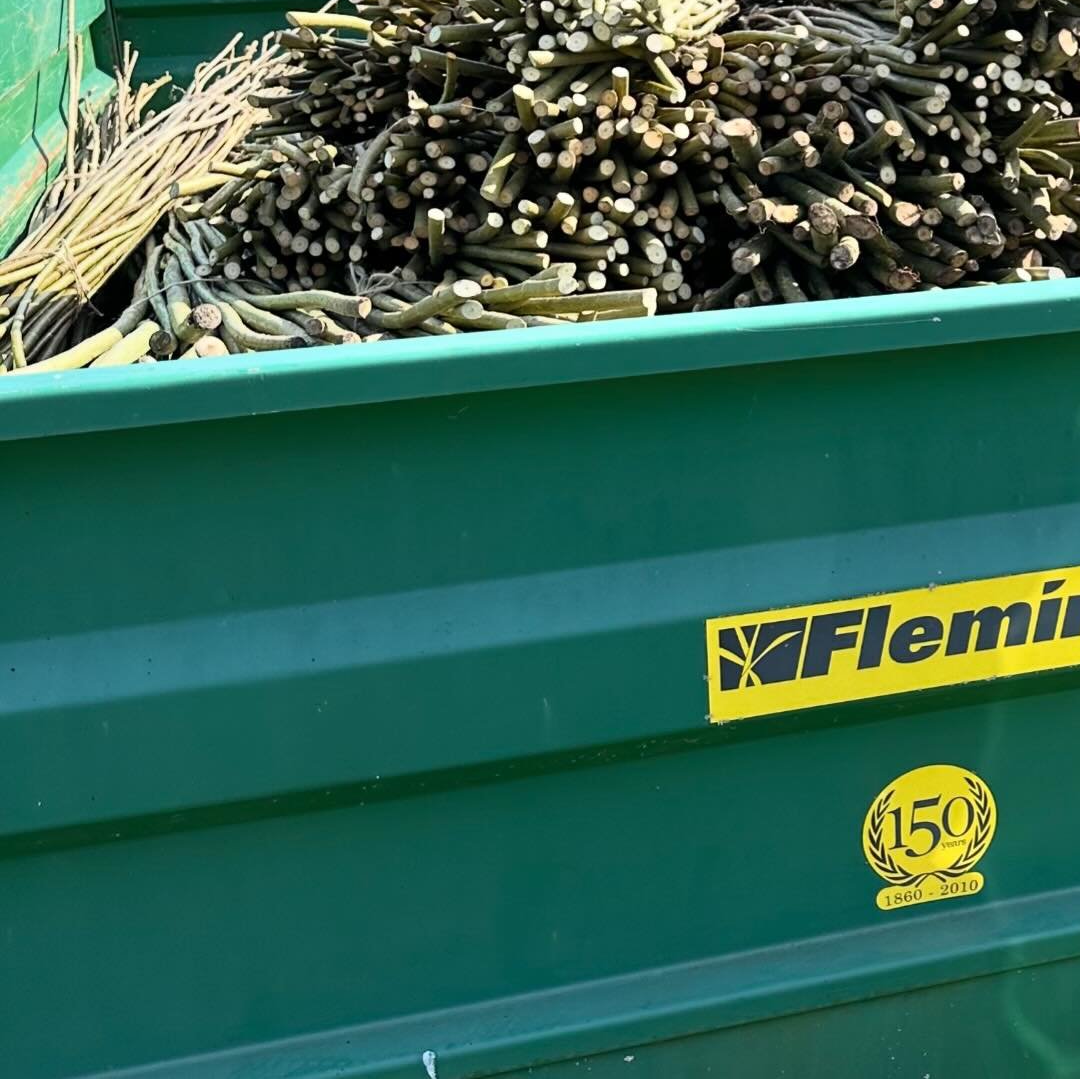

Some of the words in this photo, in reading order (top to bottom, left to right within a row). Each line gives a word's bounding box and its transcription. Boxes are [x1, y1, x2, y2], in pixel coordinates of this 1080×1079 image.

[887, 794, 975, 858] 150
[884, 888, 923, 907] 1860
[940, 879, 979, 896] 2010
